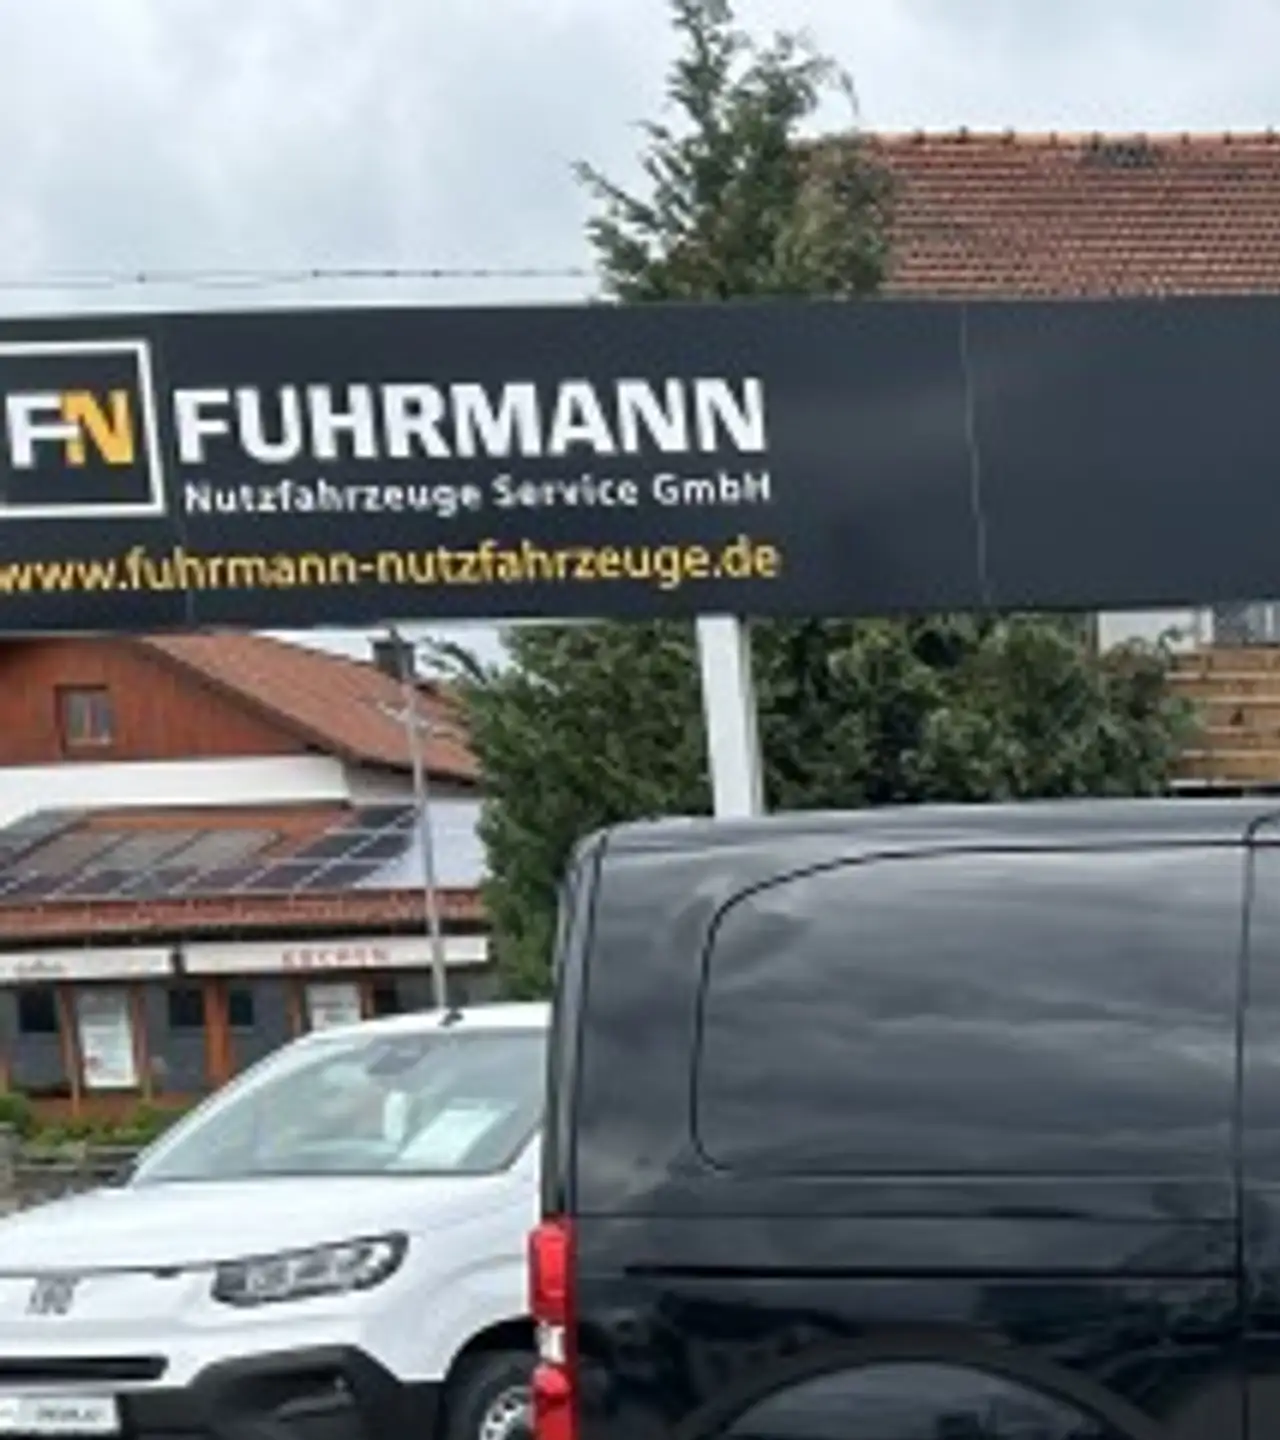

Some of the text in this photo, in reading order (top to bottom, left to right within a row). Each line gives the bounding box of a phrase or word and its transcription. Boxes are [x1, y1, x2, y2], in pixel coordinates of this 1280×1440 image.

[172, 376, 766, 464] FUHRMANN
[183, 470, 771, 517] Nutzfahrzeuge Service GmbH
[0, 534, 782, 592] www.fuhrmann-nutzfahrzeuge.de
